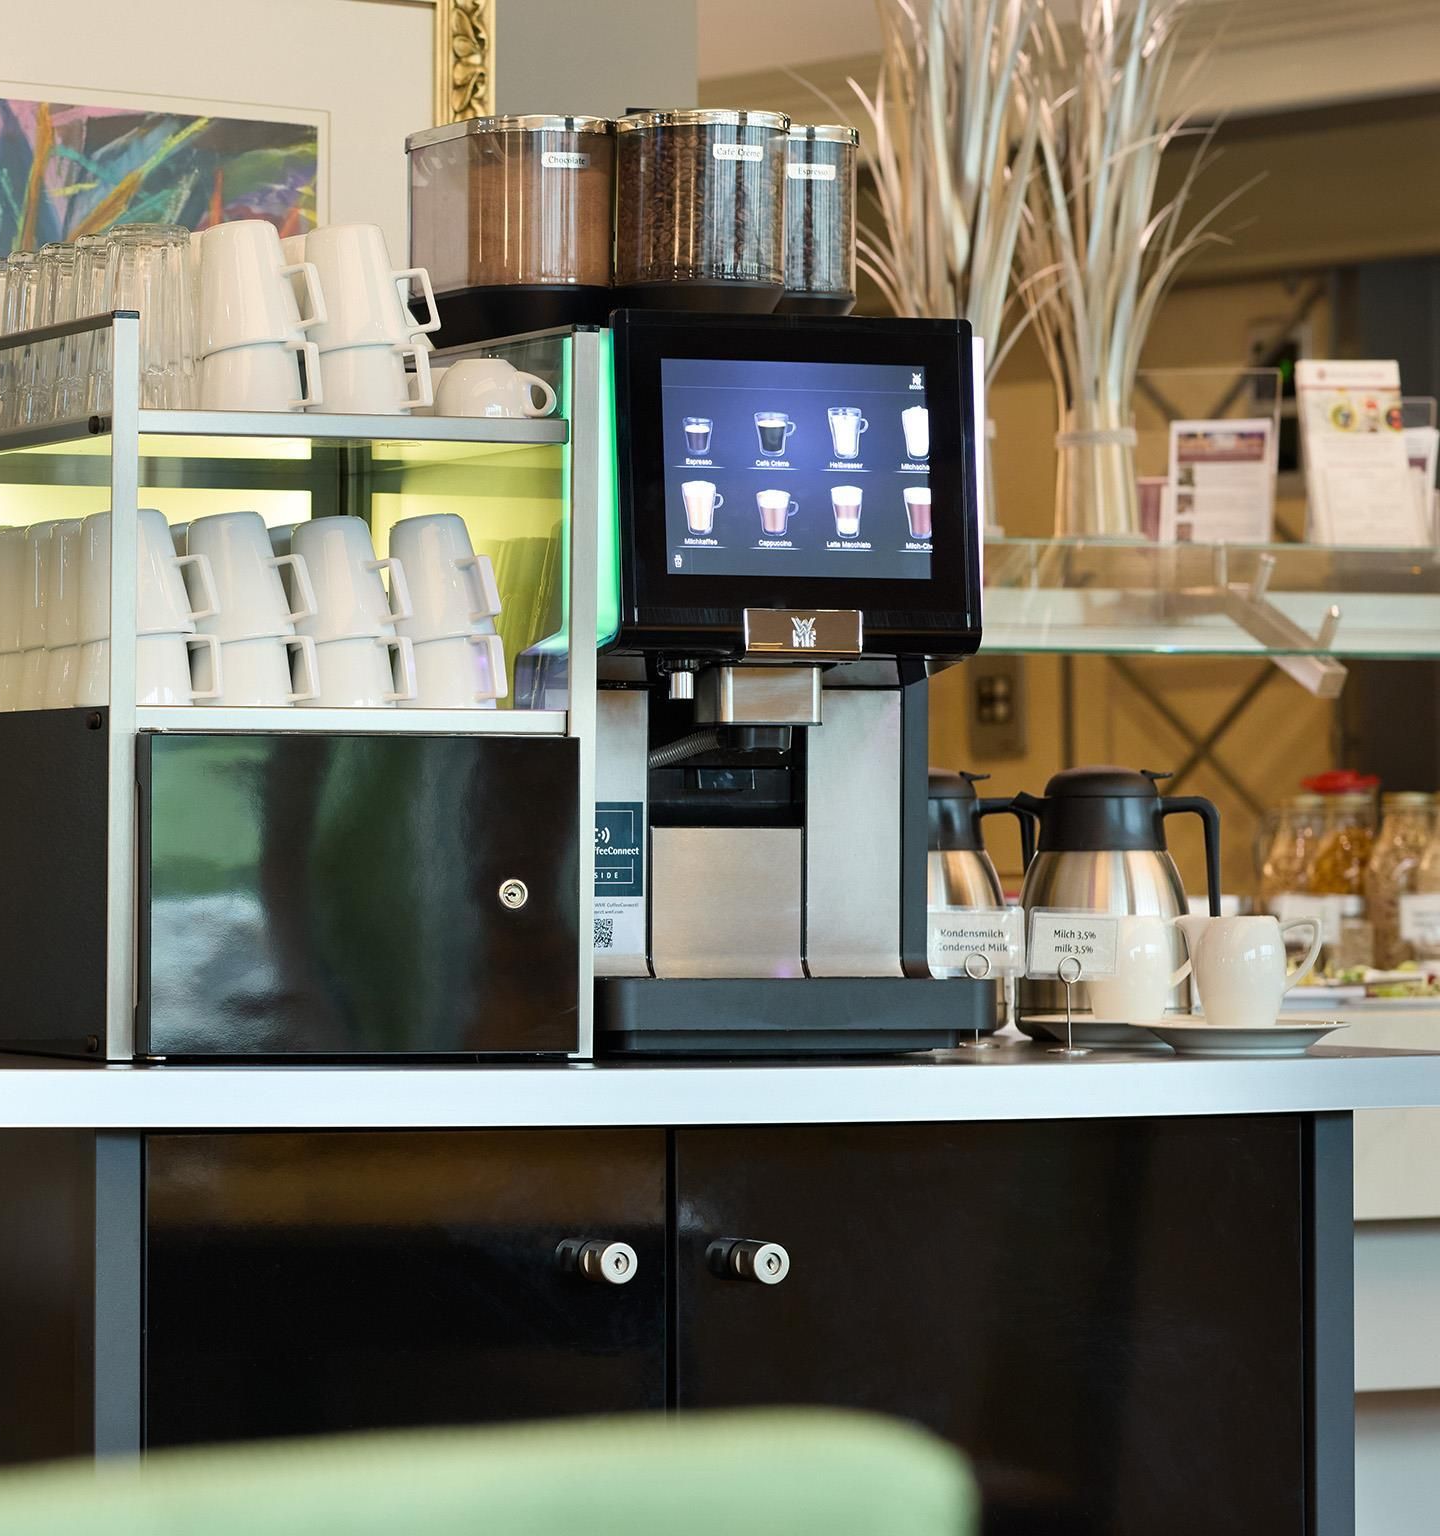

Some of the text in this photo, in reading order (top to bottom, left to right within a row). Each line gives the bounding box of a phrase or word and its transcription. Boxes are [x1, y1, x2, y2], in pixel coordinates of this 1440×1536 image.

[547, 155, 585, 165] Chocolate
[685, 458, 713, 466] Espresso
[684, 537, 718, 546] Milchkaffee
[758, 539, 793, 548] Cappuccino
[842, 541, 872, 549] Macchiato
[594, 846, 640, 855] feeConnect
[940, 928, 1004, 938] Kondensmilch
[1054, 929, 1097, 940] Milch 3,5%
[988, 943, 1008, 952] Milk
[1054, 944, 1094, 955] milk 3,5%
